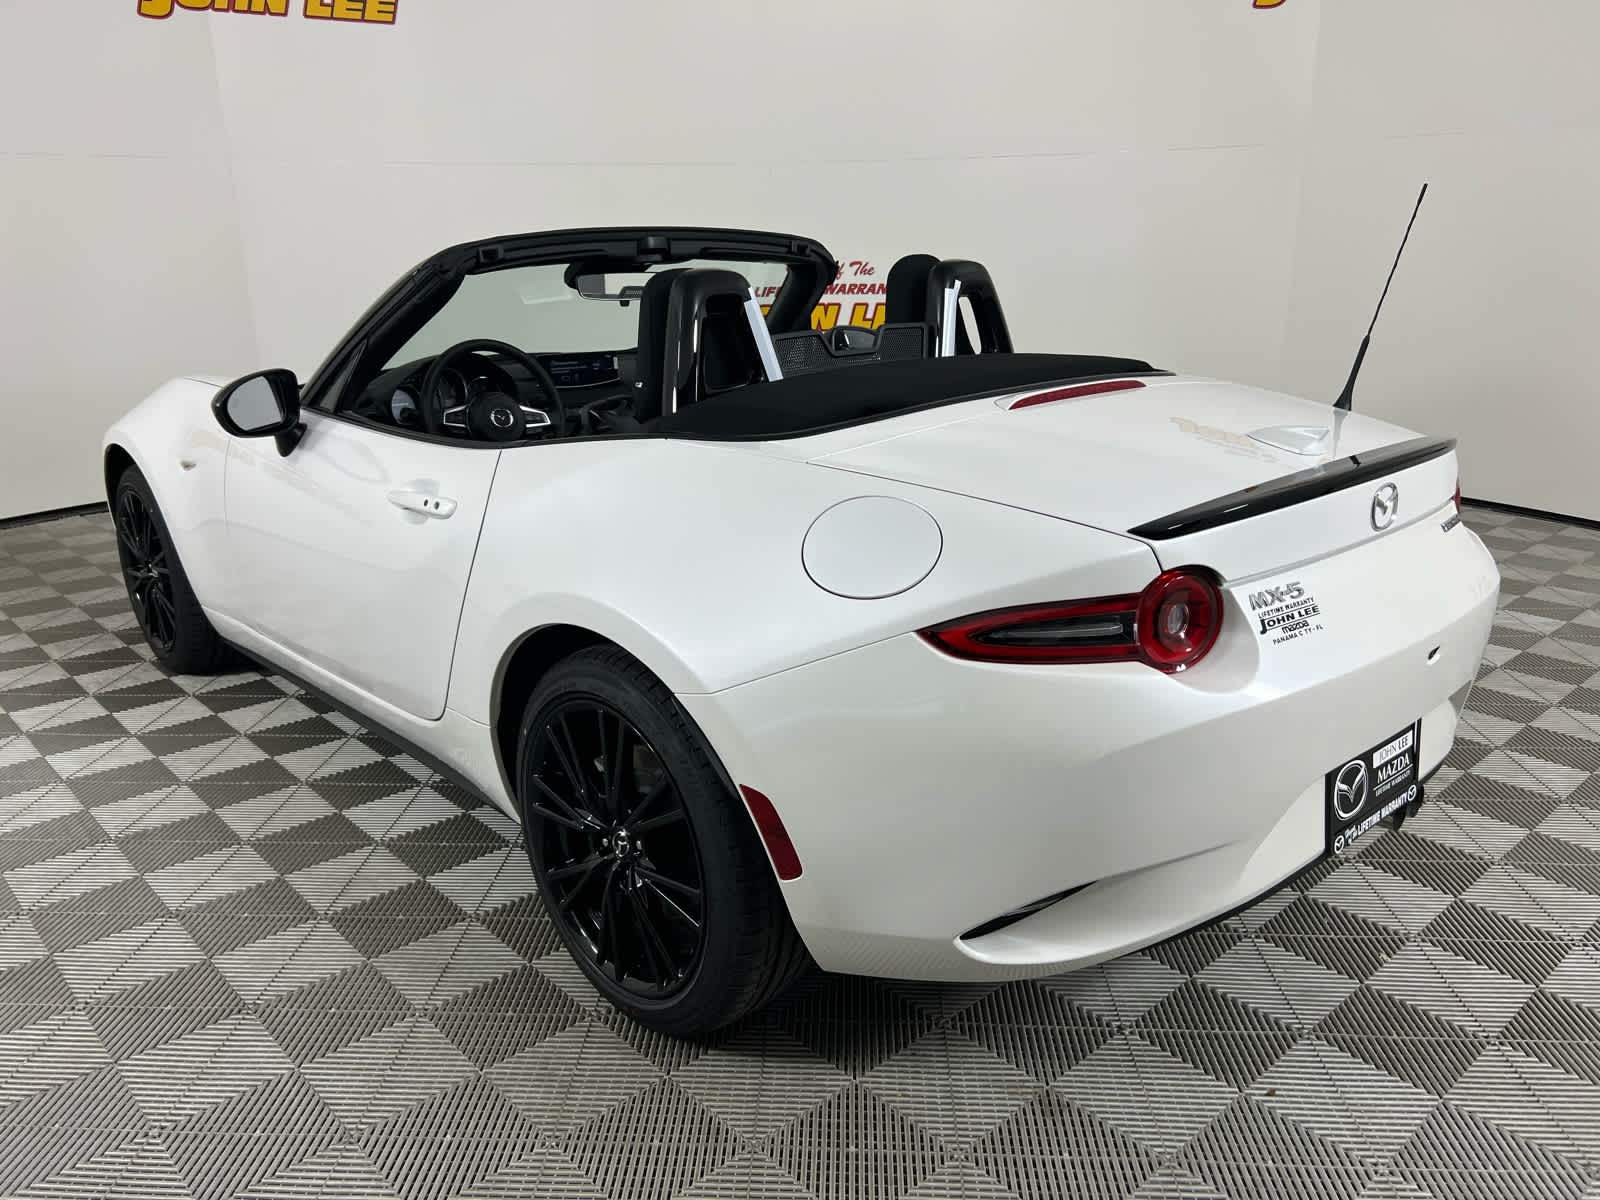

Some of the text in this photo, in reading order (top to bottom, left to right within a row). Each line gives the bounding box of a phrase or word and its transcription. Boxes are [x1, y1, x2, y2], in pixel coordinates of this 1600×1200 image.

[303, 0, 398, 24] LEE
[849, 261, 875, 276] The
[1249, 582, 1304, 610] MX-5
[1258, 597, 1314, 619] LIFETIME WARRANTY
[1260, 605, 1320, 635] JOHN LEE
[1273, 633, 1297, 645] PANAMA
[1377, 735, 1409, 763] JOHN LEE
[1377, 752, 1410, 784] MAZDA
[1358, 811, 1380, 835] LIFETIME
[1382, 793, 1407, 817] WARRANTY
